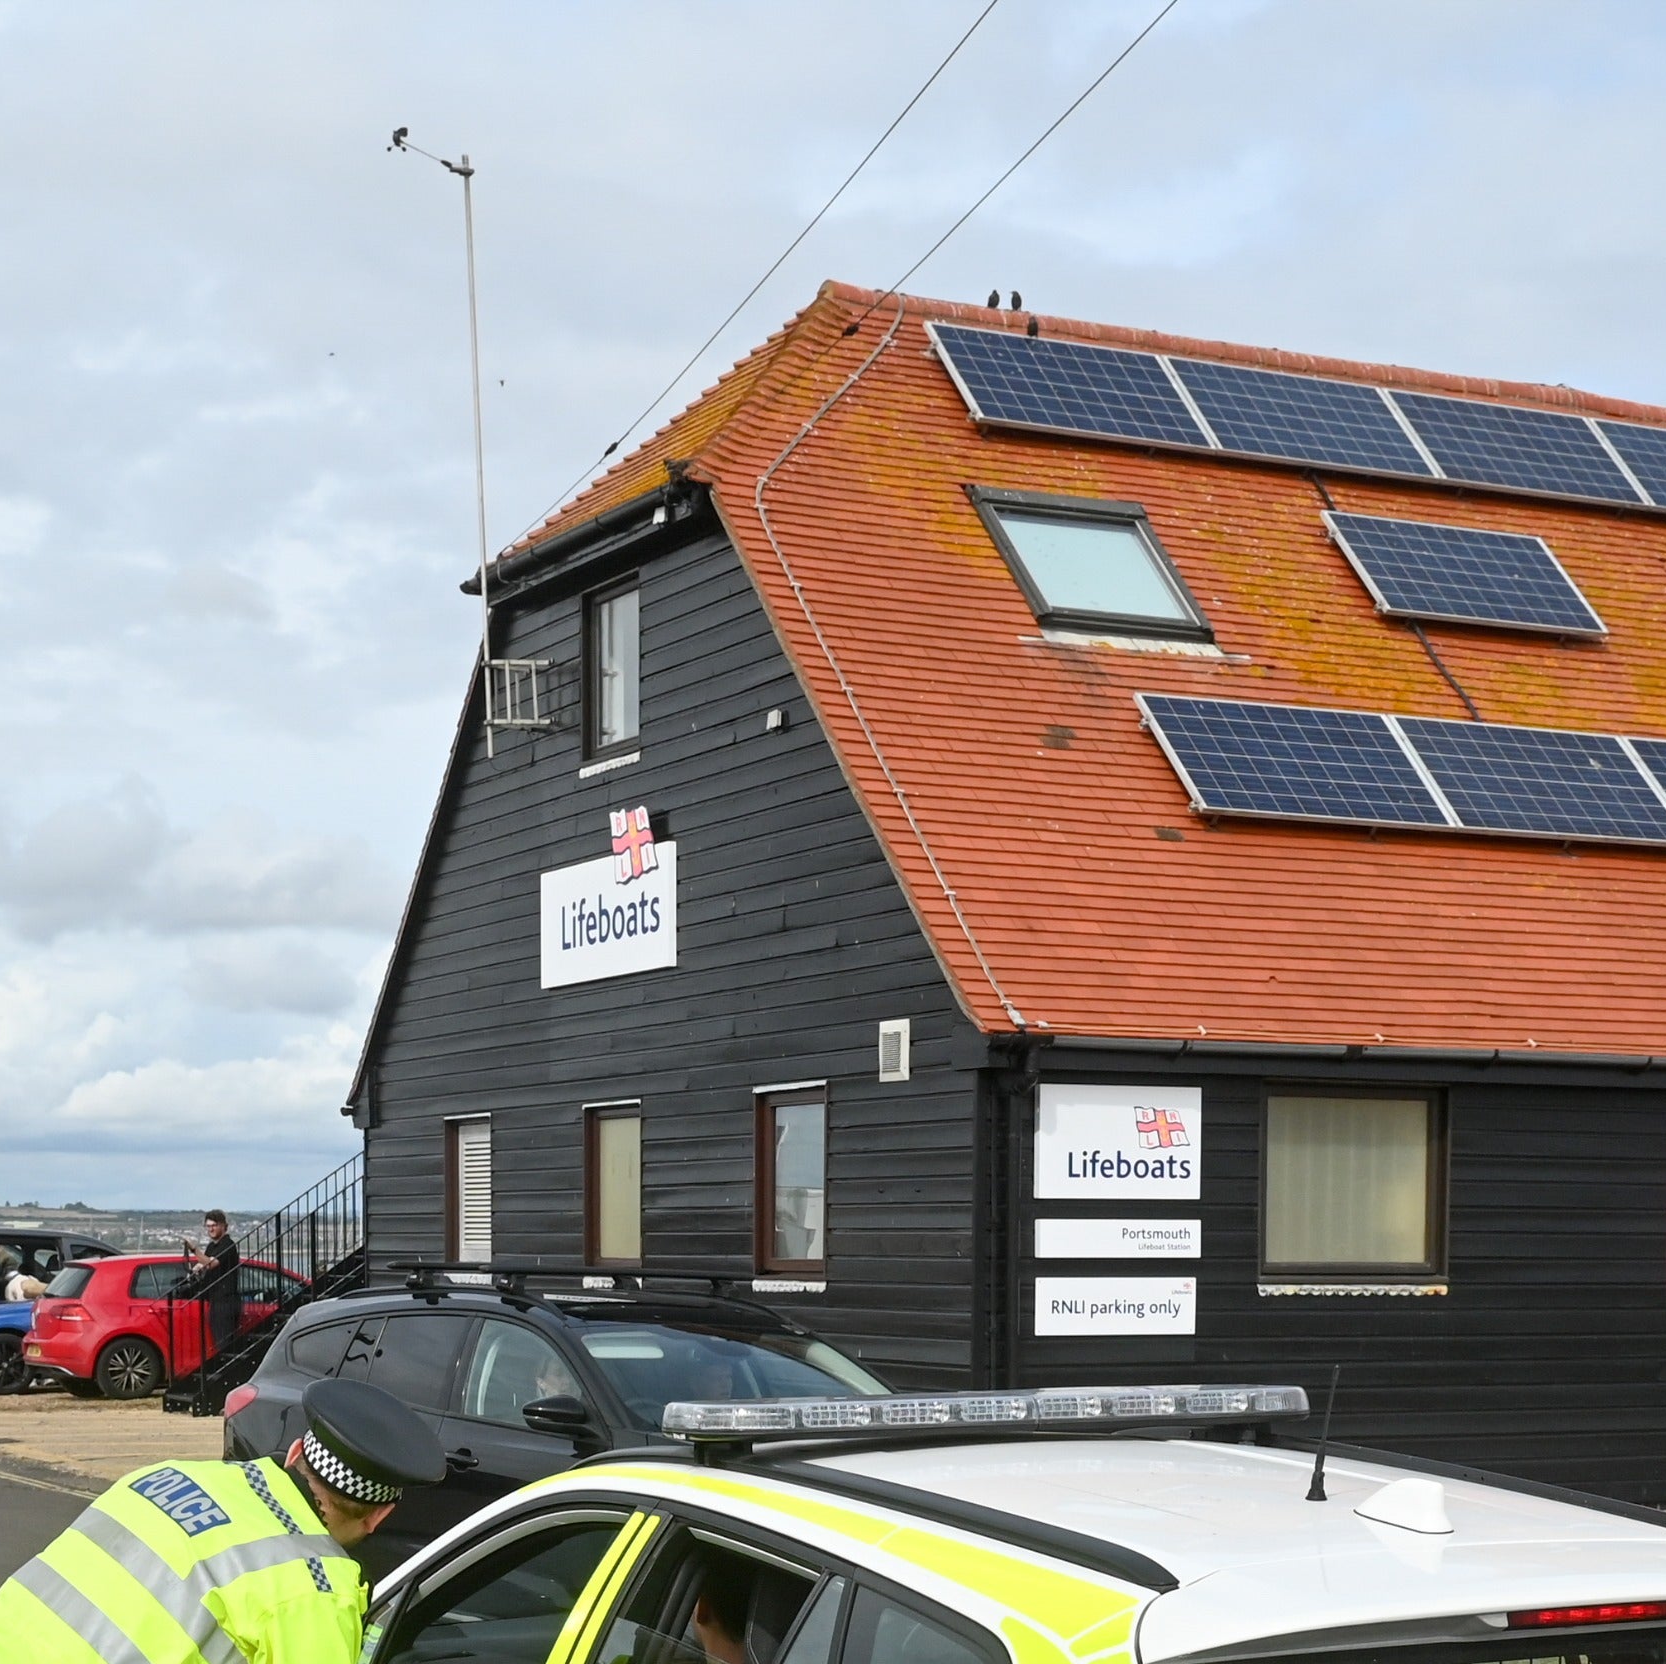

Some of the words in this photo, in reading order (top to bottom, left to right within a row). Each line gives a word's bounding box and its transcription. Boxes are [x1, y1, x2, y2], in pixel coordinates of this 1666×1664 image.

[561, 890, 661, 951] Lifeboats
[1068, 1150, 1191, 1179] Lifeboats
[1122, 1227, 1191, 1240] Portsmouth
[1138, 1243, 1166, 1251] Lifeboat
[1167, 1243, 1191, 1251] Station
[1051, 1299, 1085, 1315] RNLI
[1090, 1299, 1145, 1319] parking
[1149, 1299, 1181, 1318] only
[130, 1468, 228, 1533] POLICE
